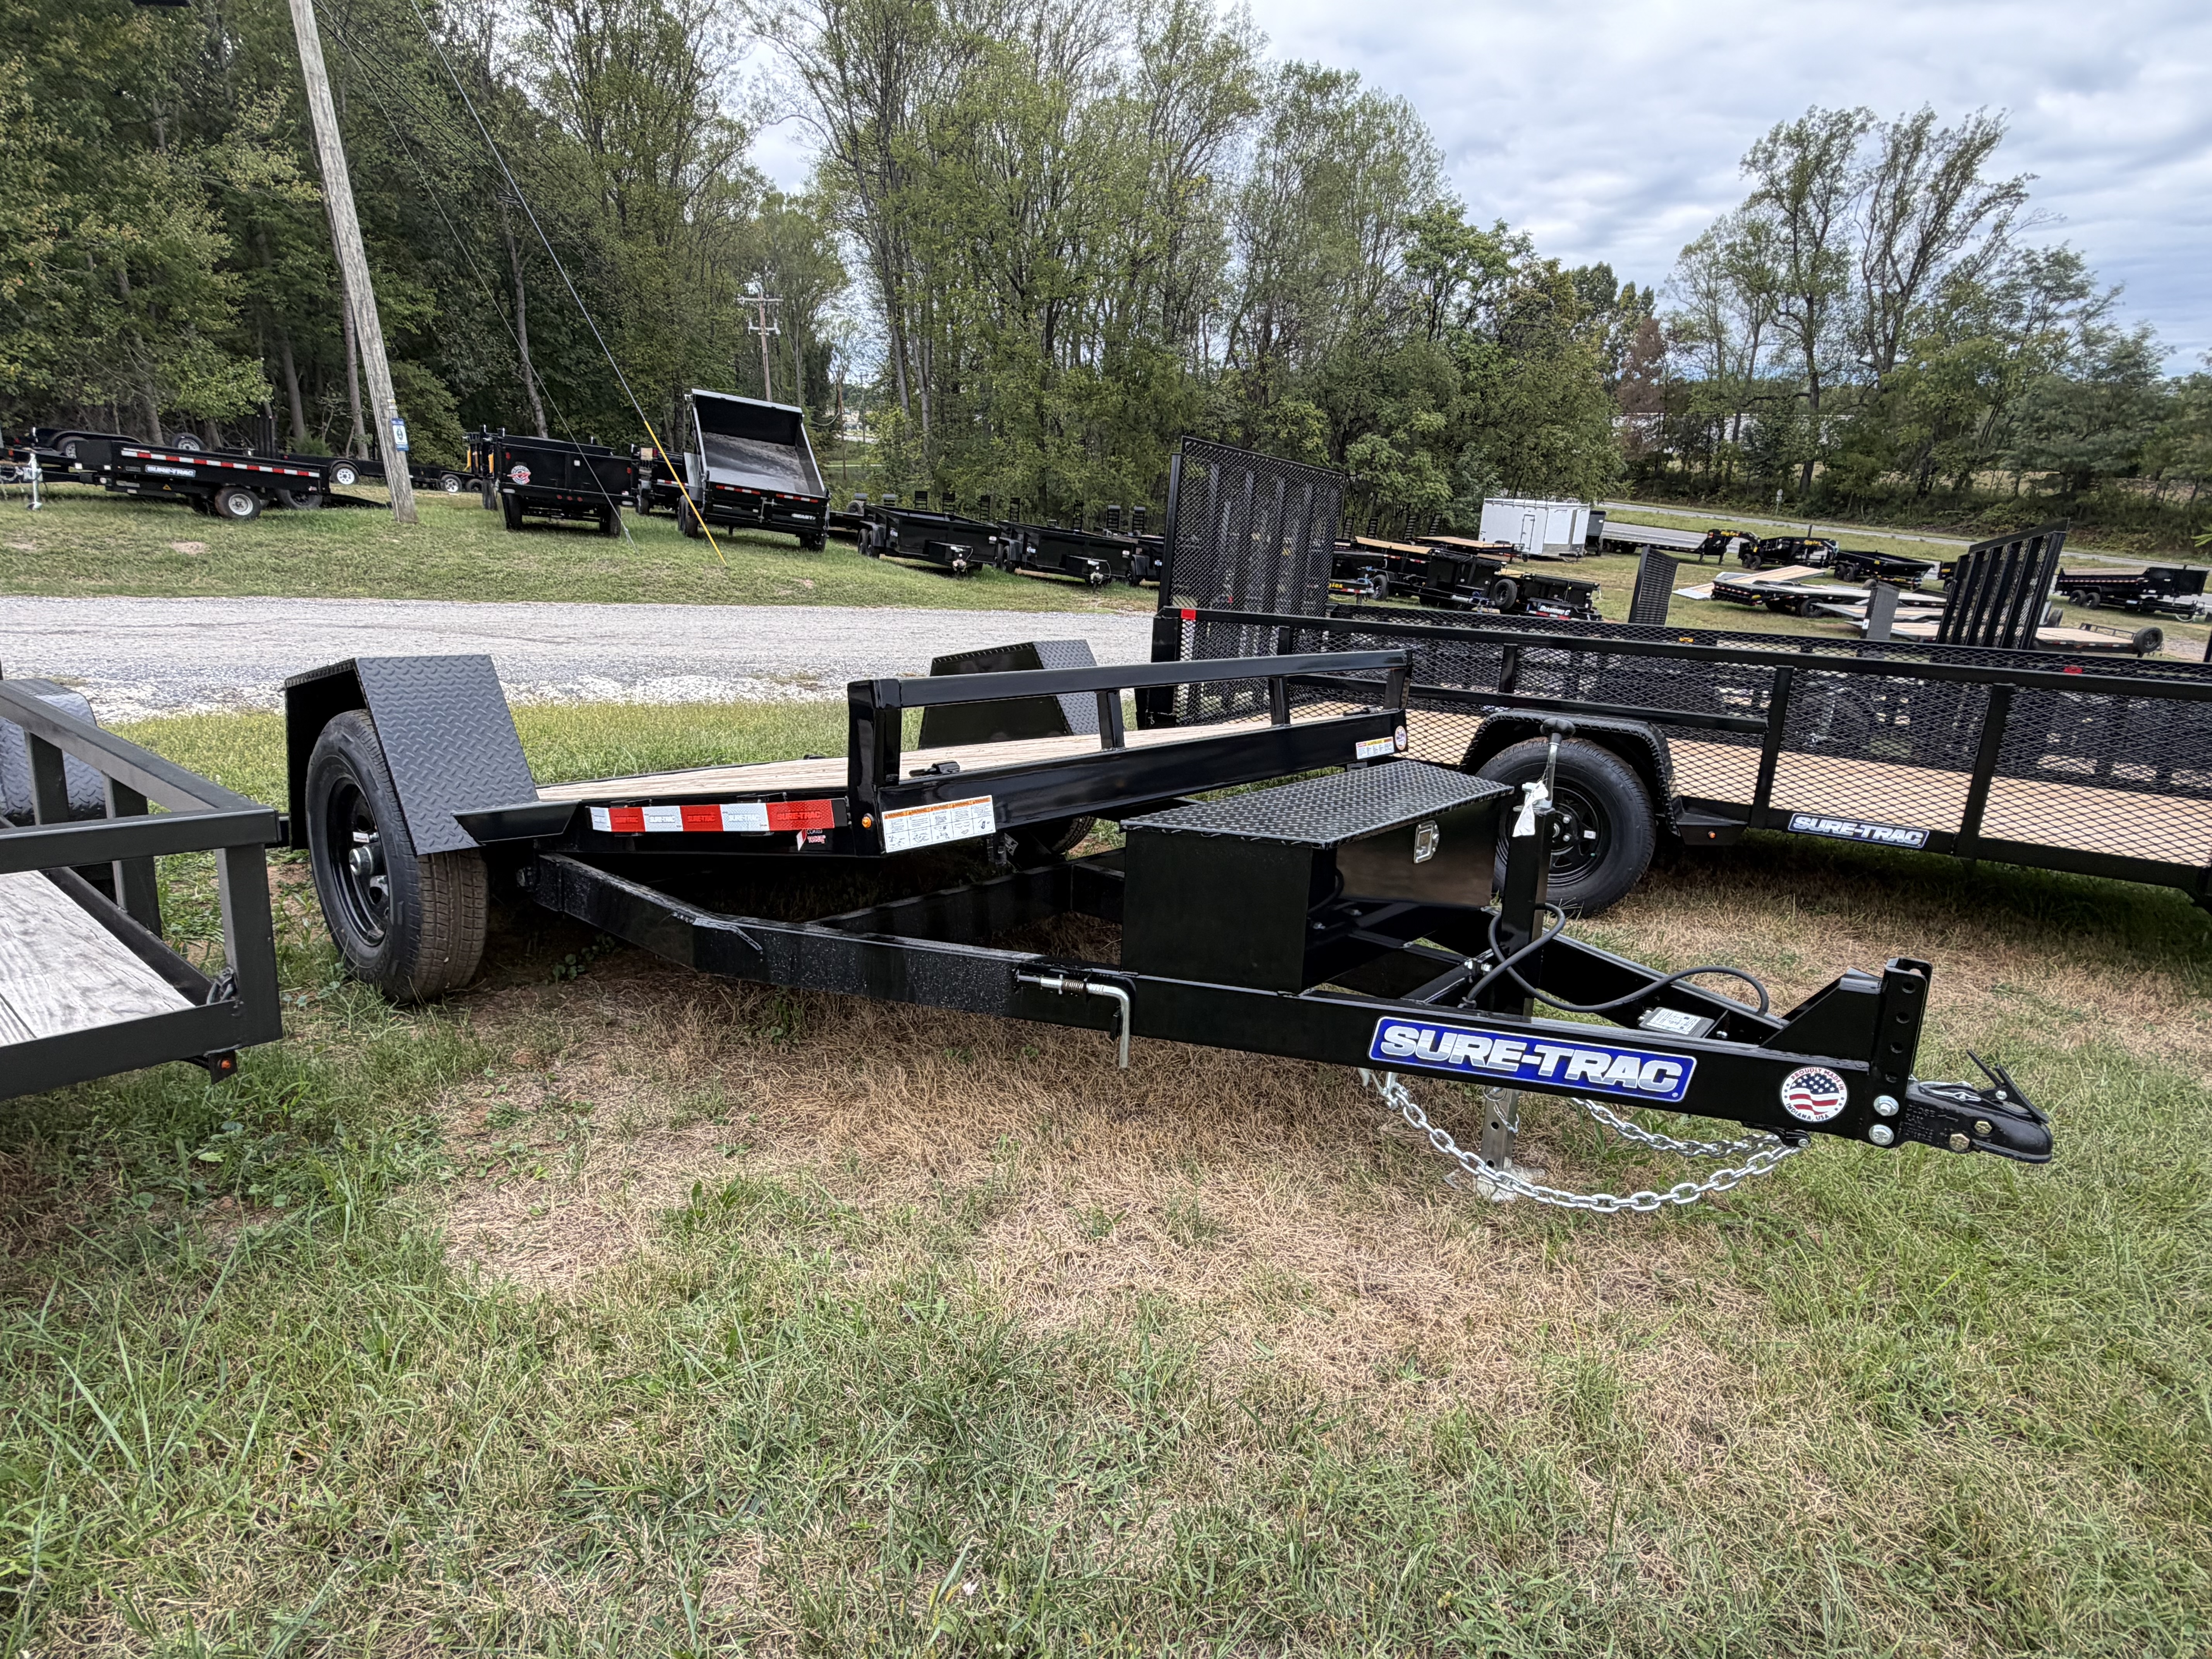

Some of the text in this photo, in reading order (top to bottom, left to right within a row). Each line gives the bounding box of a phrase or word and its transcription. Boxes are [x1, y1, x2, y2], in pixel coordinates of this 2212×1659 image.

[777, 811, 821, 820] SURE-TRAC
[1793, 816, 1923, 845] SURE-TRAC
[1381, 1025, 1682, 1092] SURE-TRAC
[1791, 1068, 1822, 1080] PROUDLY
[1824, 1070, 1841, 1083] MADE
